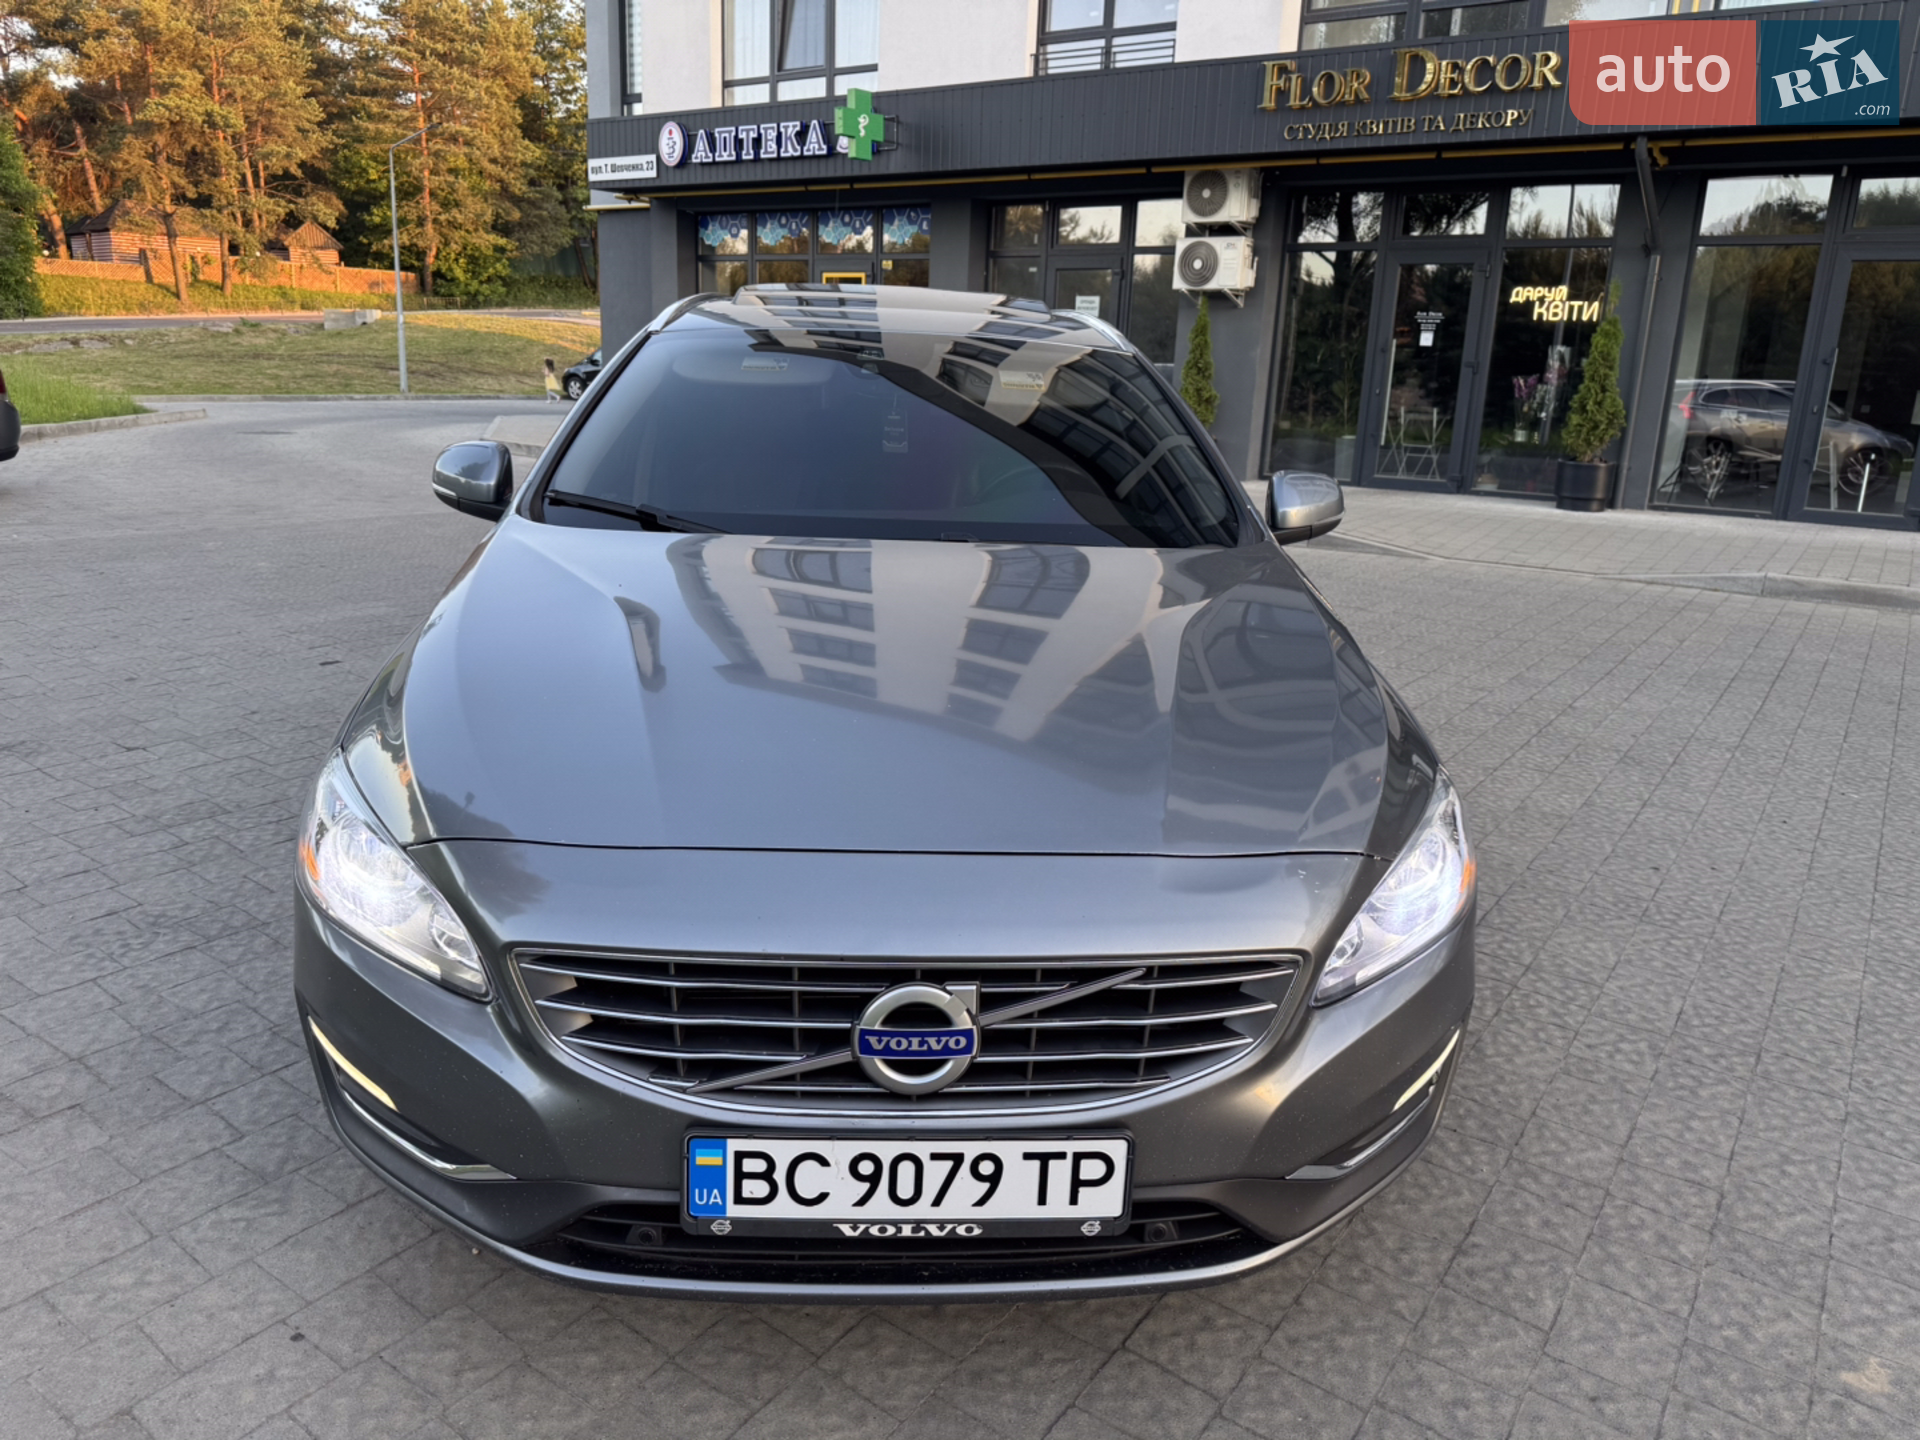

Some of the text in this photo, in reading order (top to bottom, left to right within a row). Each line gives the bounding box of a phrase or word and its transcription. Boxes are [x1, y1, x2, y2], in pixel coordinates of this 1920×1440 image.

[1257, 47, 1563, 111] FLOR DECOR
[1283, 109, 1535, 141] СТУДІЯ КВІТІВ ТА ДЕКОРУ
[692, 119, 829, 163] АПТЕКА
[645, 160, 654, 172] 23
[1509, 285, 1568, 303] ДАРУЙ
[1532, 300, 1600, 322] КВІТИ
[865, 1035, 968, 1052] VOLVO
[733, 1150, 1115, 1207] BC 9079 TP
[695, 1188, 723, 1206] UA
[833, 1223, 983, 1237] VOLVO
